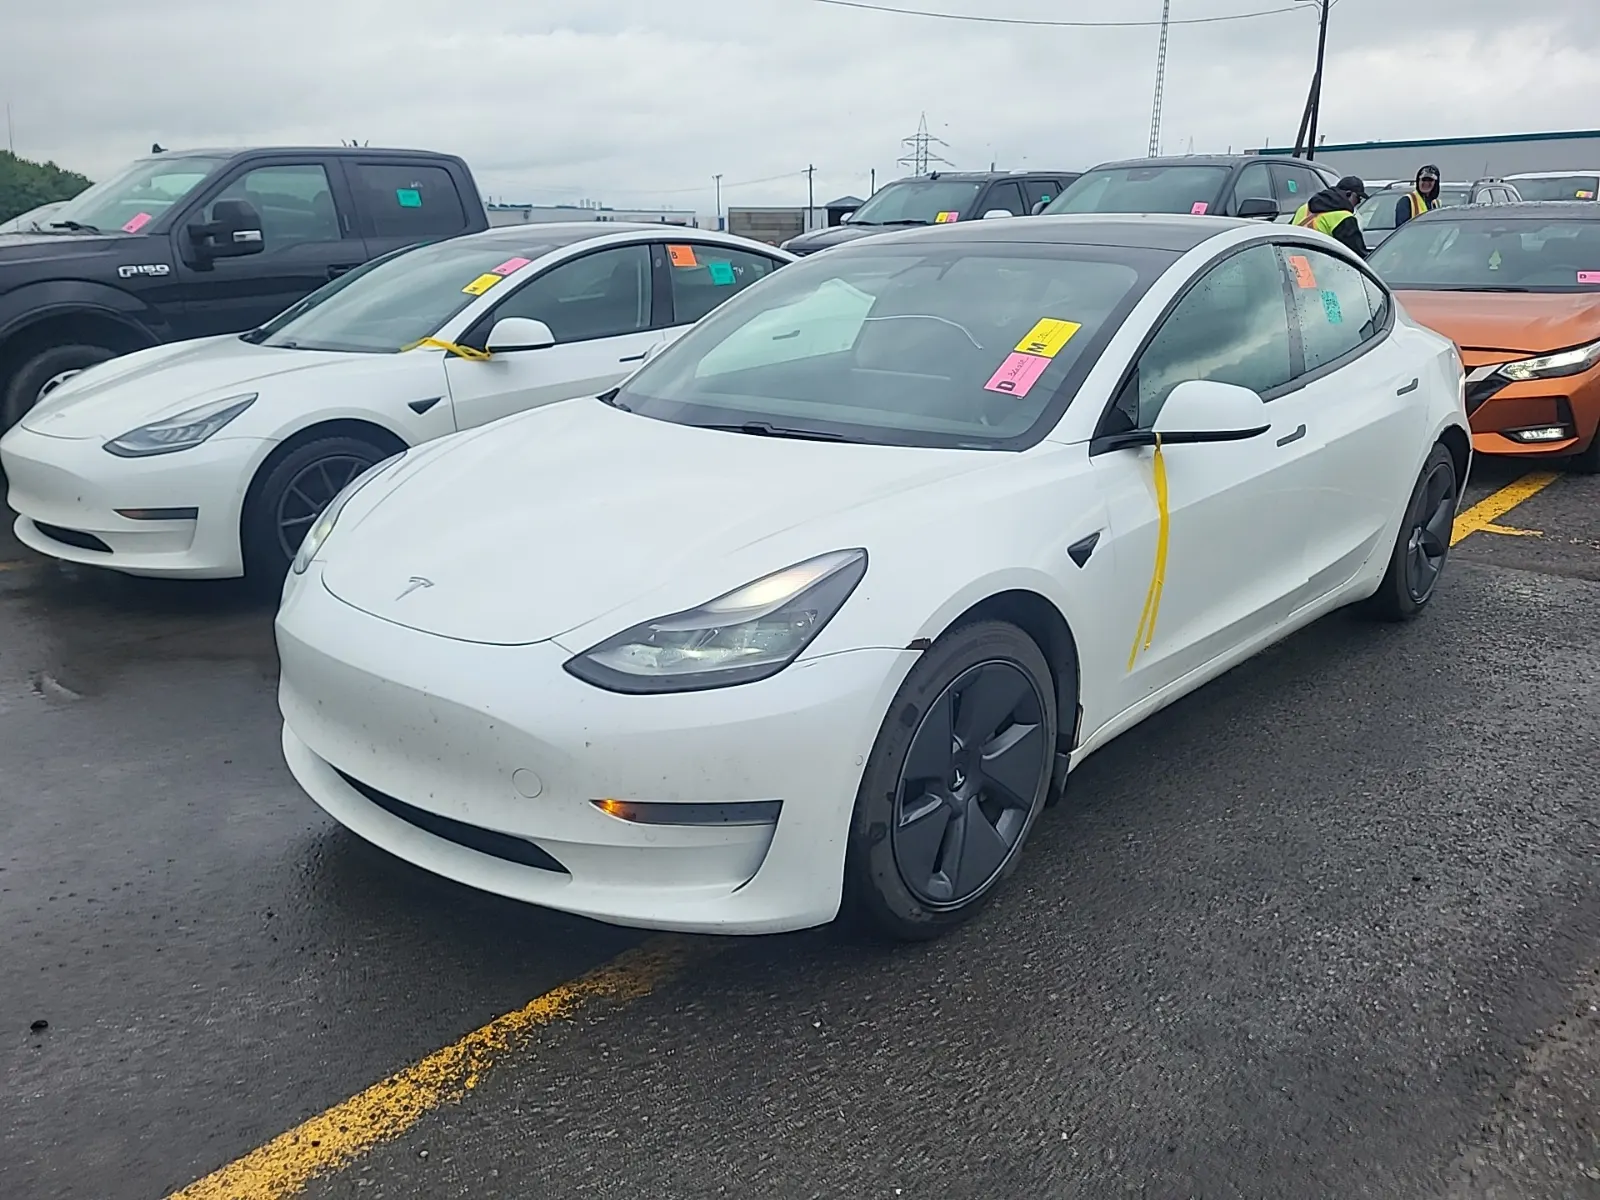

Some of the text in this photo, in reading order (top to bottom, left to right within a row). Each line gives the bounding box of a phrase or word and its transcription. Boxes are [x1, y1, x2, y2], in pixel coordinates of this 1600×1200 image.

[671, 251, 678, 259] B
[1026, 342, 1048, 353] M
[996, 380, 1016, 392] D
